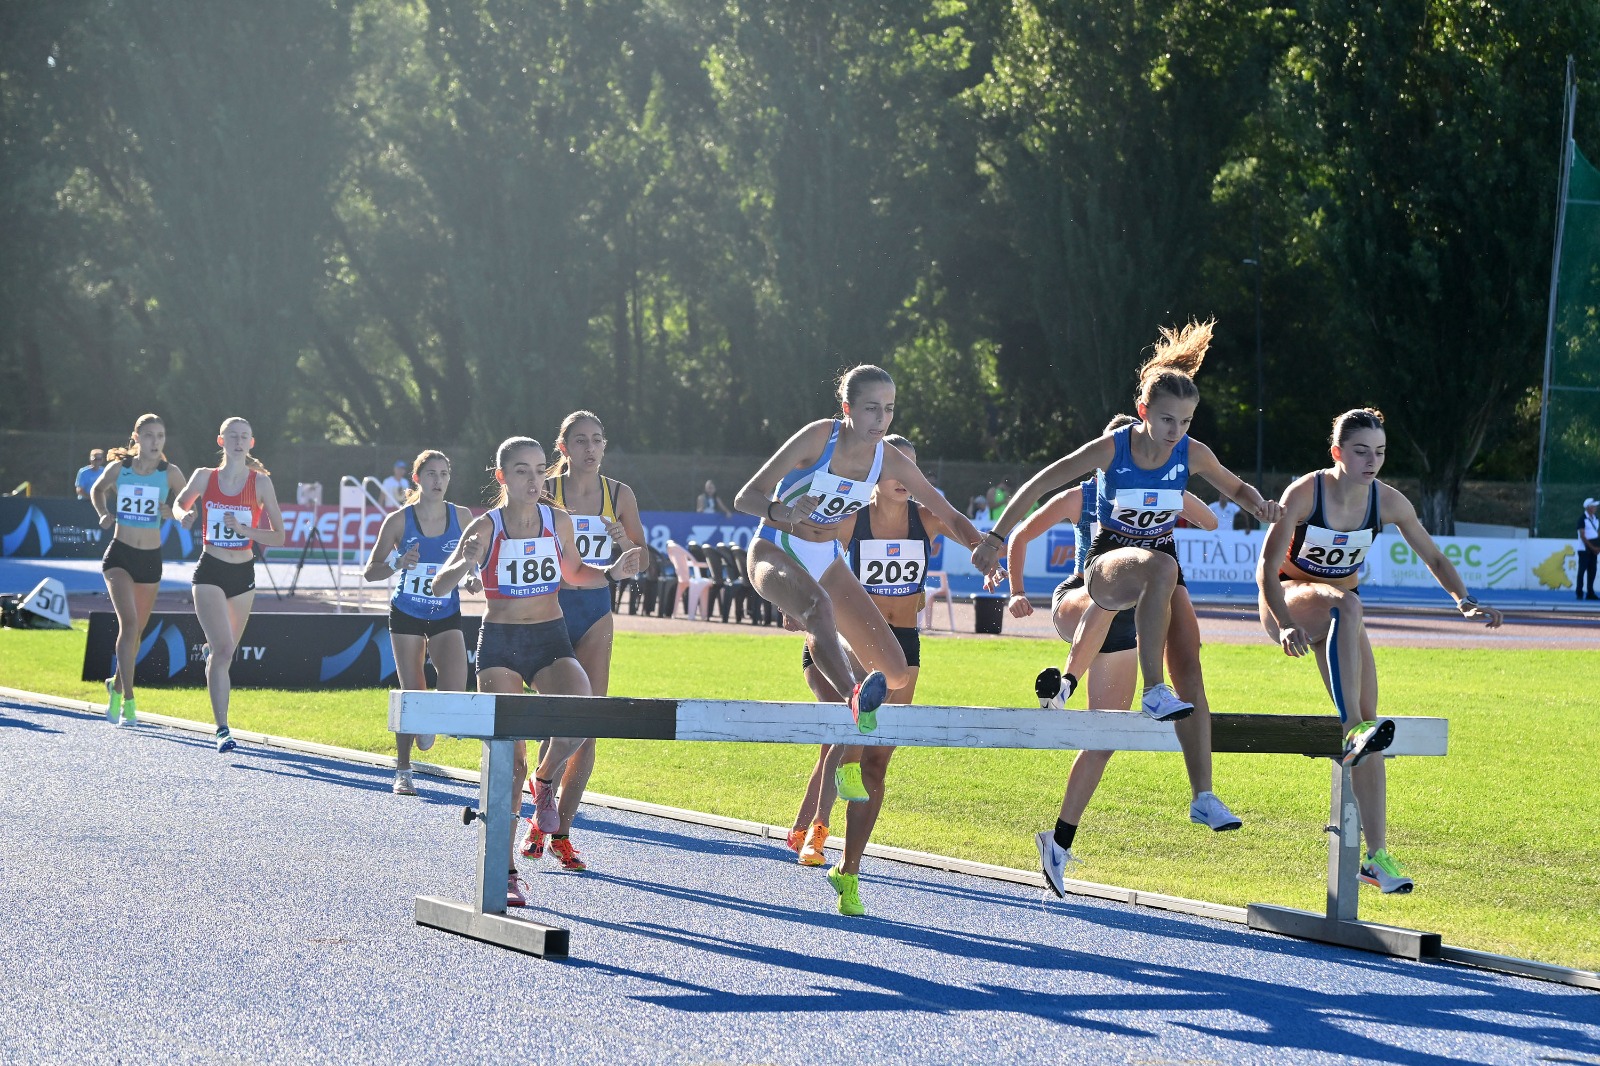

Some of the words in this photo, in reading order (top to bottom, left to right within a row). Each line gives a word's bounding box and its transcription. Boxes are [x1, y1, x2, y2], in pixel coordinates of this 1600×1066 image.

[121, 498, 155, 514] 212
[1118, 509, 1175, 528] 205
[85, 529, 101, 542] TV
[1144, 527, 1163, 535] 2025
[576, 535, 607, 558] 07
[1109, 534, 1154, 548] NIKE
[1155, 535, 1175, 547] PR
[1176, 534, 1228, 564] ITTÀ
[1305, 547, 1361, 565] 201
[1390, 542, 1482, 567] eec
[506, 557, 557, 585] 186
[866, 561, 920, 585] 203
[1308, 564, 1329, 573] RIETI
[510, 588, 530, 596] RIETI
[531, 586, 549, 594] 2025
[893, 586, 910, 594] 2025
[36, 587, 65, 615] 50
[241, 646, 267, 660] TV
